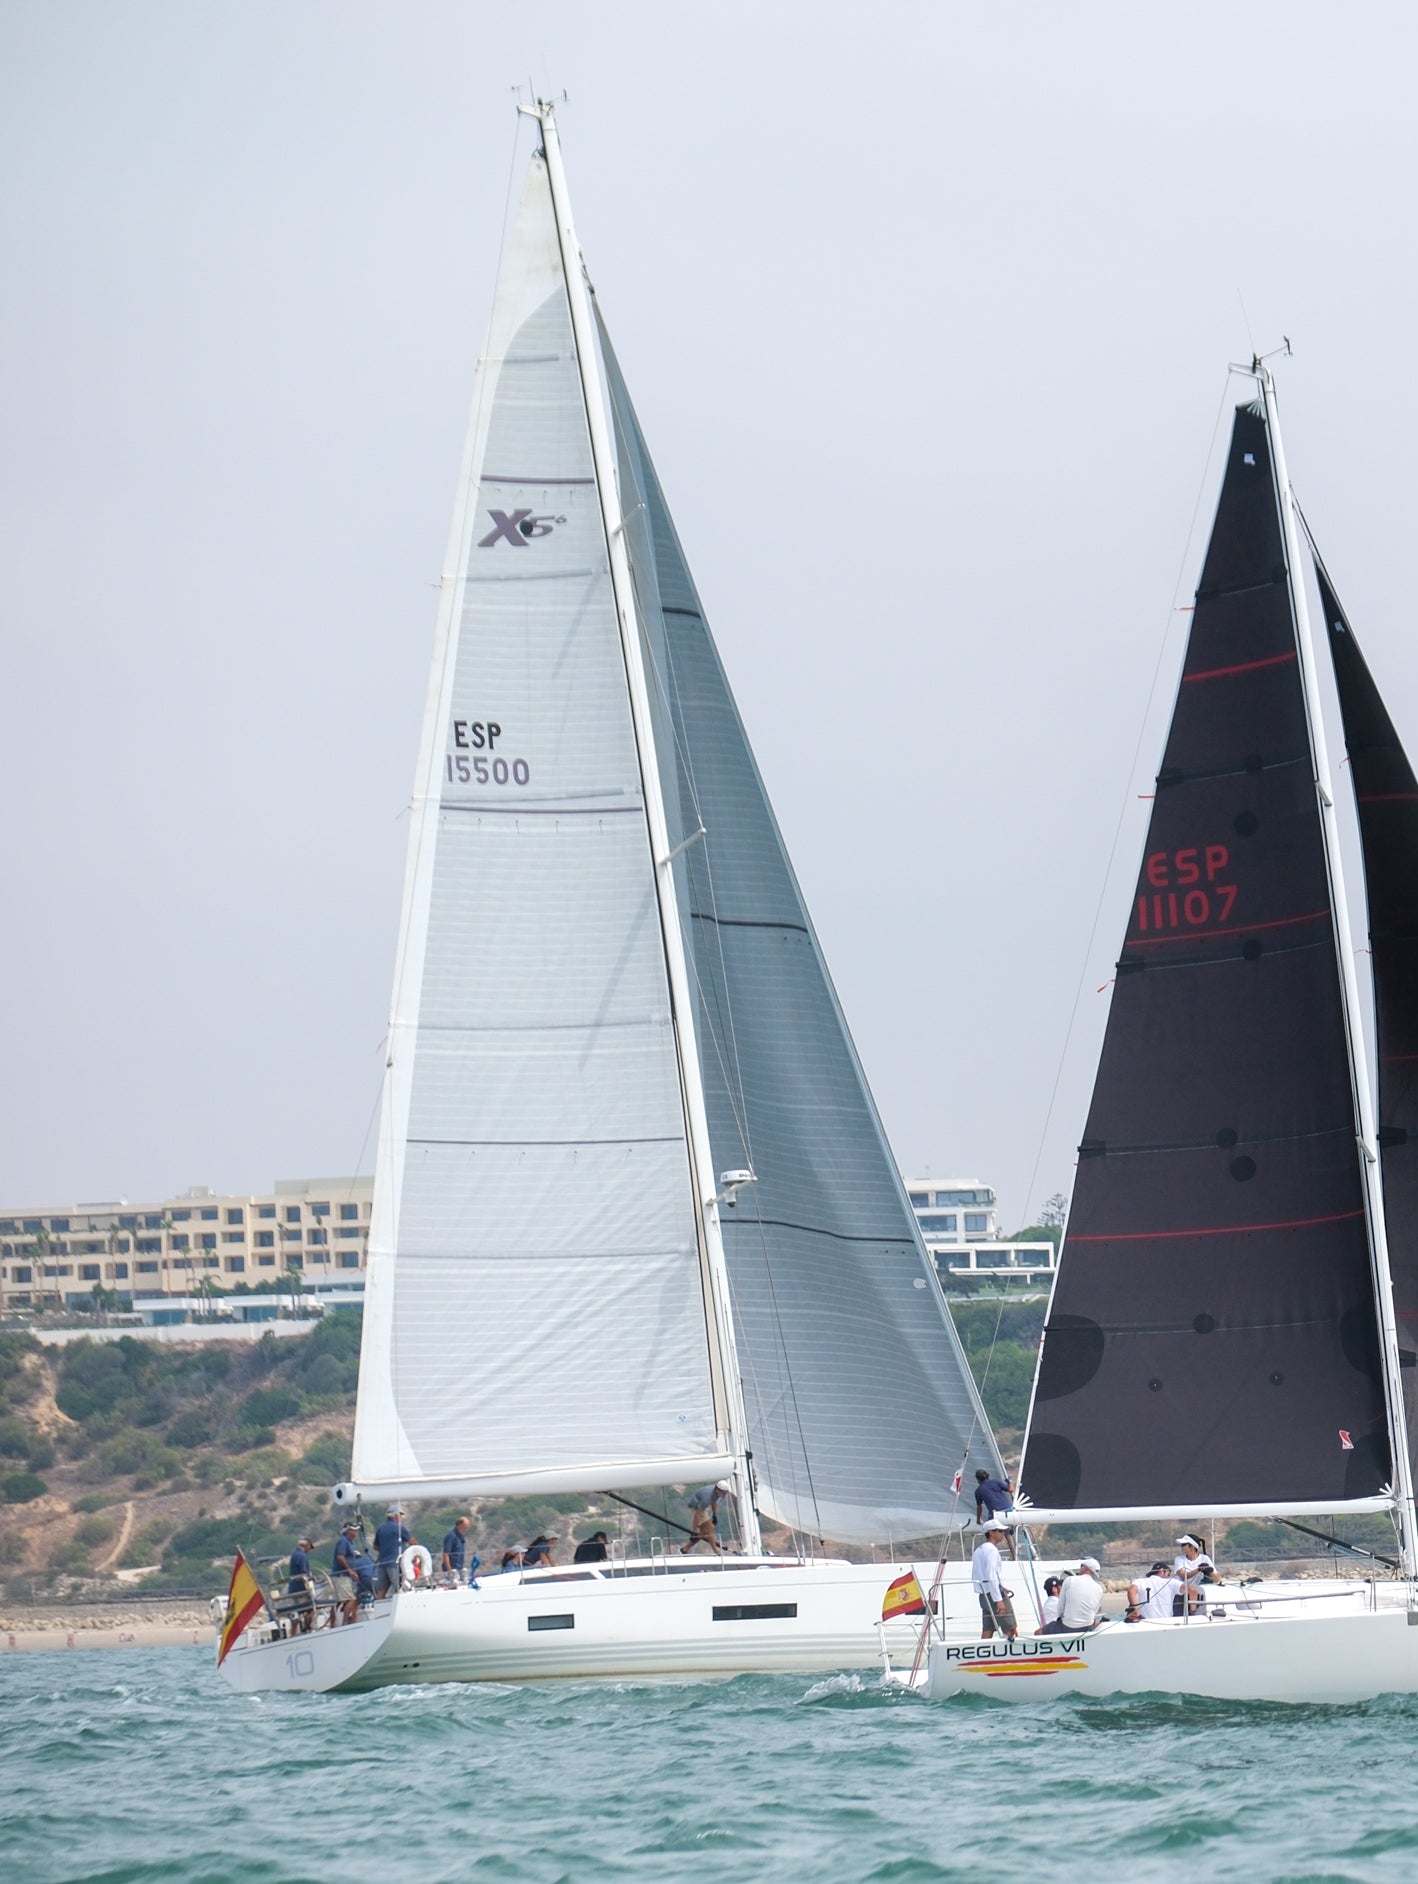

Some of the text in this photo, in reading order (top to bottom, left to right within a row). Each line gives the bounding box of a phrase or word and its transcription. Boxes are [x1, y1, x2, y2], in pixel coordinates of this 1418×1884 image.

[453, 719, 501, 750] ESP
[446, 753, 529, 785] 15500
[1147, 845, 1229, 887] ESP
[1138, 884, 1238, 931] 11107
[285, 1650, 315, 1679] 10
[946, 1639, 1085, 1660] REGULUS VII
